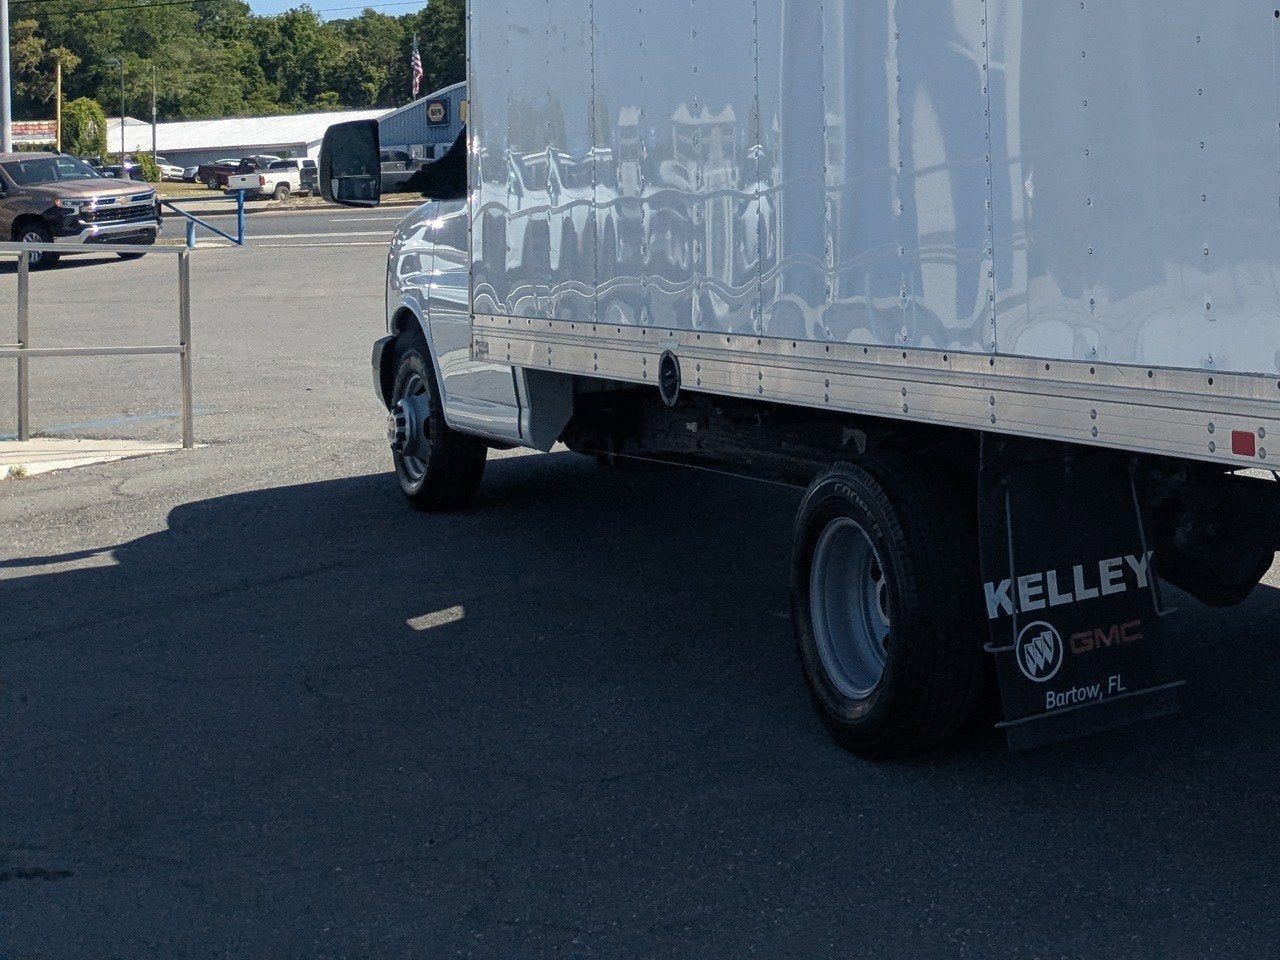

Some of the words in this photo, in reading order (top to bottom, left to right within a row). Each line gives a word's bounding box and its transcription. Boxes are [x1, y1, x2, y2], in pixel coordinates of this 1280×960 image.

[984, 551, 1153, 619] KELLEY
[1069, 620, 1144, 655] GMC
[1046, 684, 1103, 710] Bartow,
[1108, 674, 1127, 694] FL
